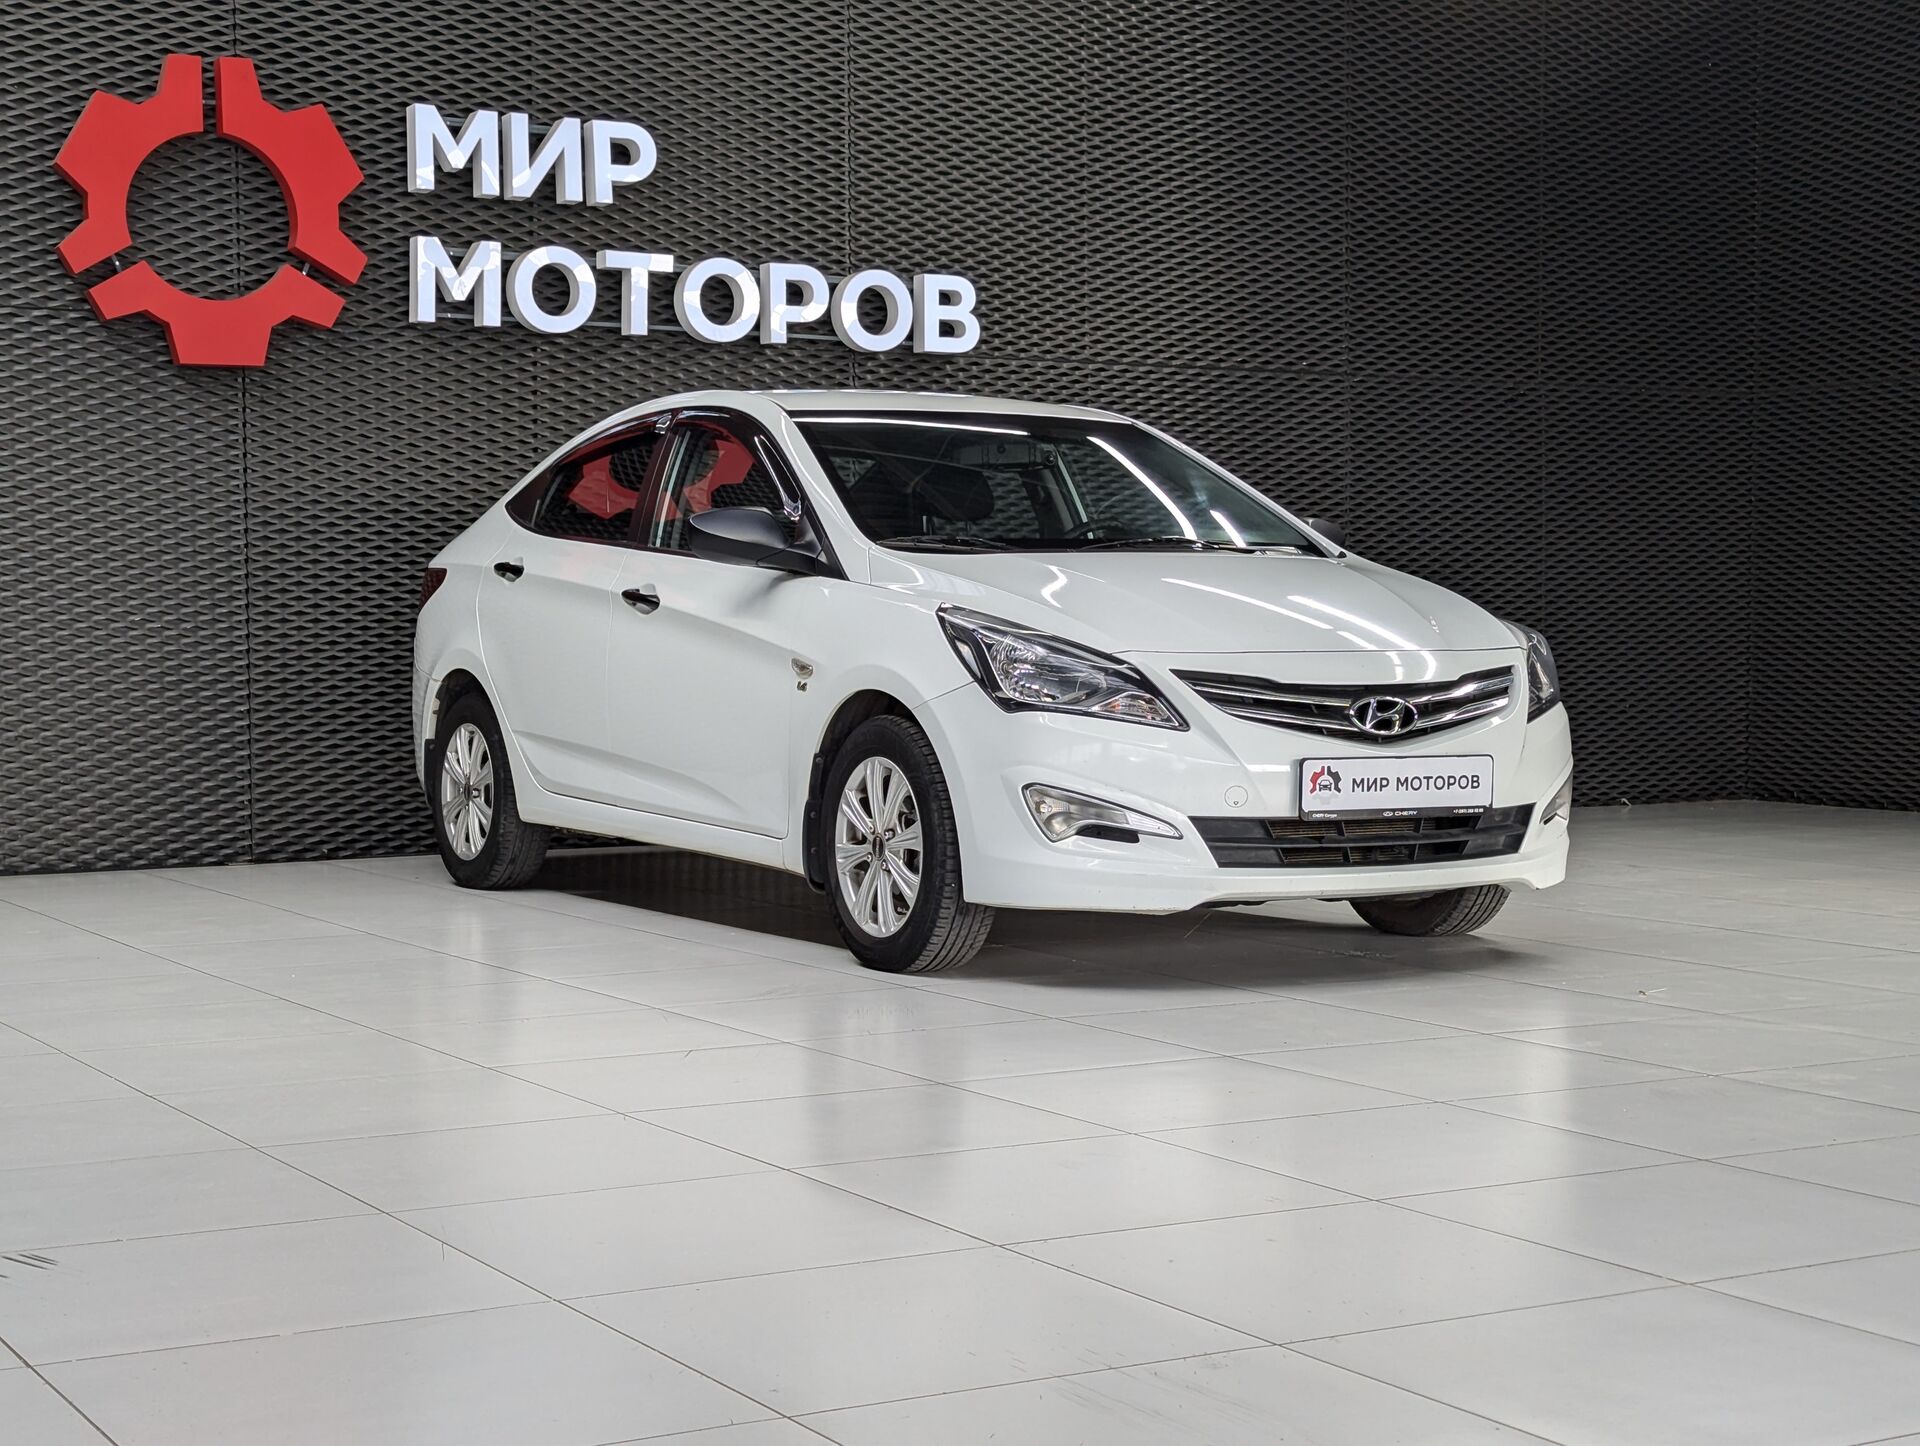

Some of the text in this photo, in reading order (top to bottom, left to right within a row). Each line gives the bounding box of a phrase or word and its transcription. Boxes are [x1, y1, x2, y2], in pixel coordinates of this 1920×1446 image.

[406, 103, 658, 207] МИР
[409, 235, 981, 354] МОТОРОВ
[1351, 774, 1481, 793] МИР МОТОРОВ
